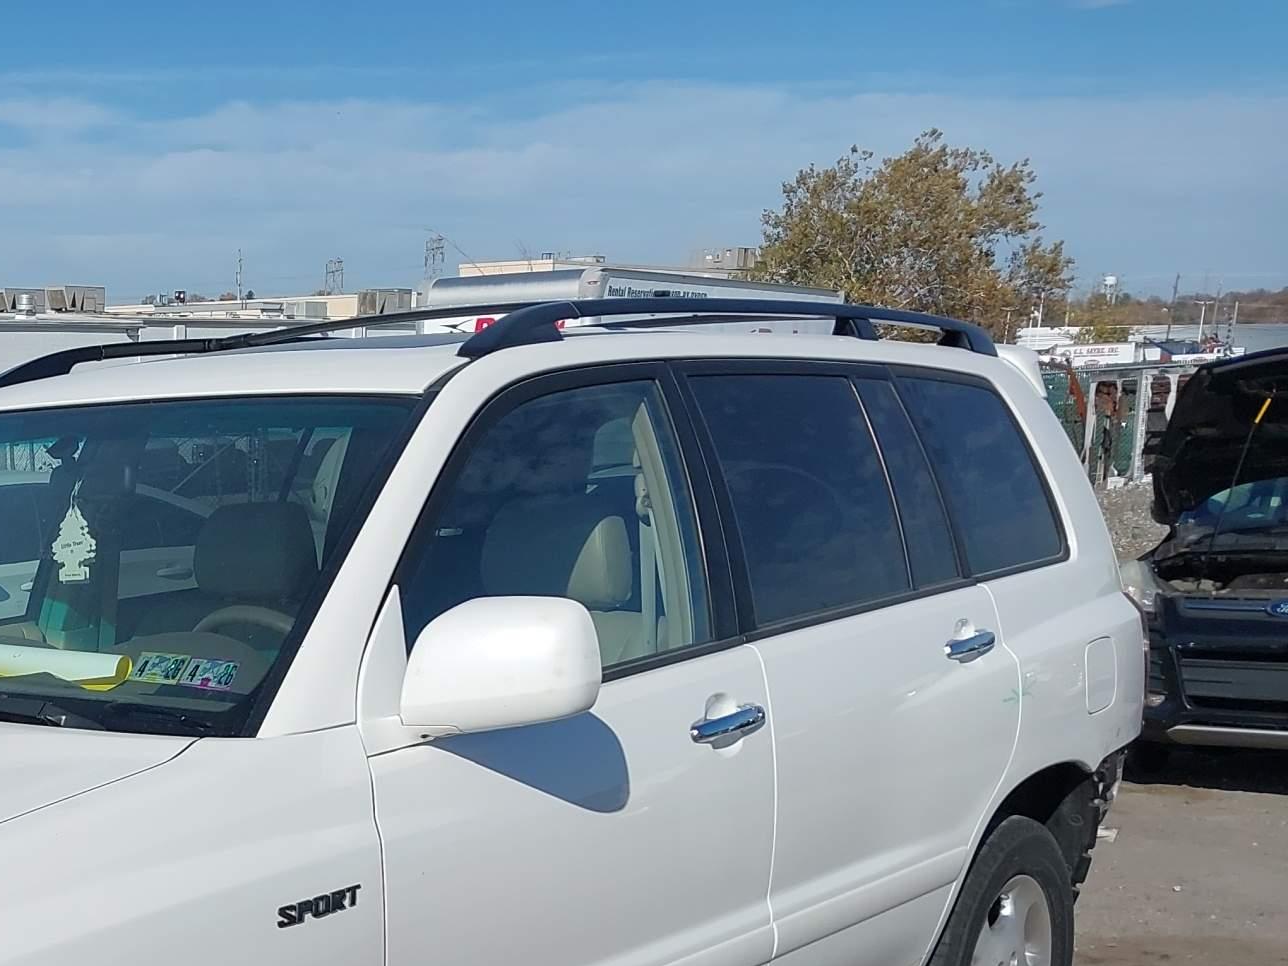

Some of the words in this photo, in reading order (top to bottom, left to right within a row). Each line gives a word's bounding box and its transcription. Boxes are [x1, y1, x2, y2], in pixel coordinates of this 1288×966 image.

[136, 660, 150, 678] 4
[186, 664, 201, 682] 4
[218, 664, 238, 686] 26
[277, 883, 362, 929] SPORT
